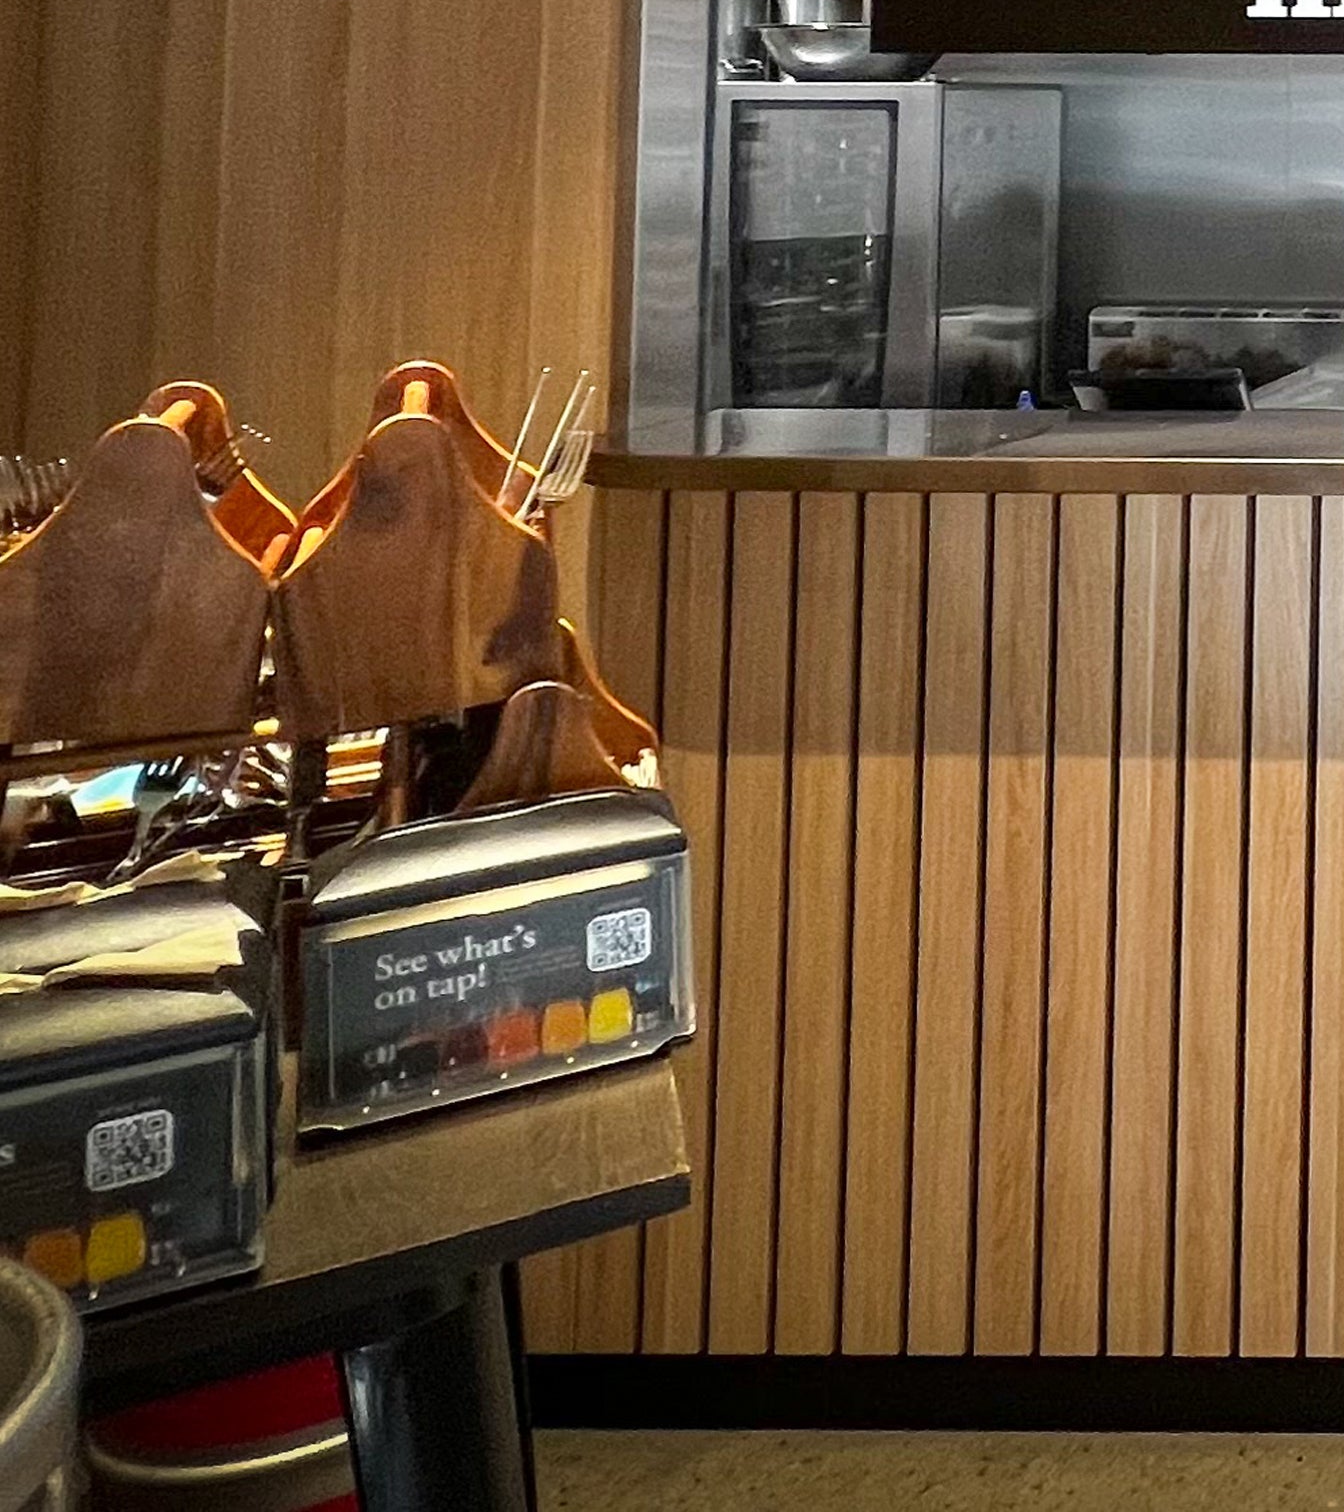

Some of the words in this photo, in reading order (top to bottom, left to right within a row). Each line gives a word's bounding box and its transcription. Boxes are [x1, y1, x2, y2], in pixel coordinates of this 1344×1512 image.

[373, 953, 429, 982] See
[437, 924, 537, 969] what's
[373, 984, 417, 1011] on
[427, 962, 488, 1002] tap!
